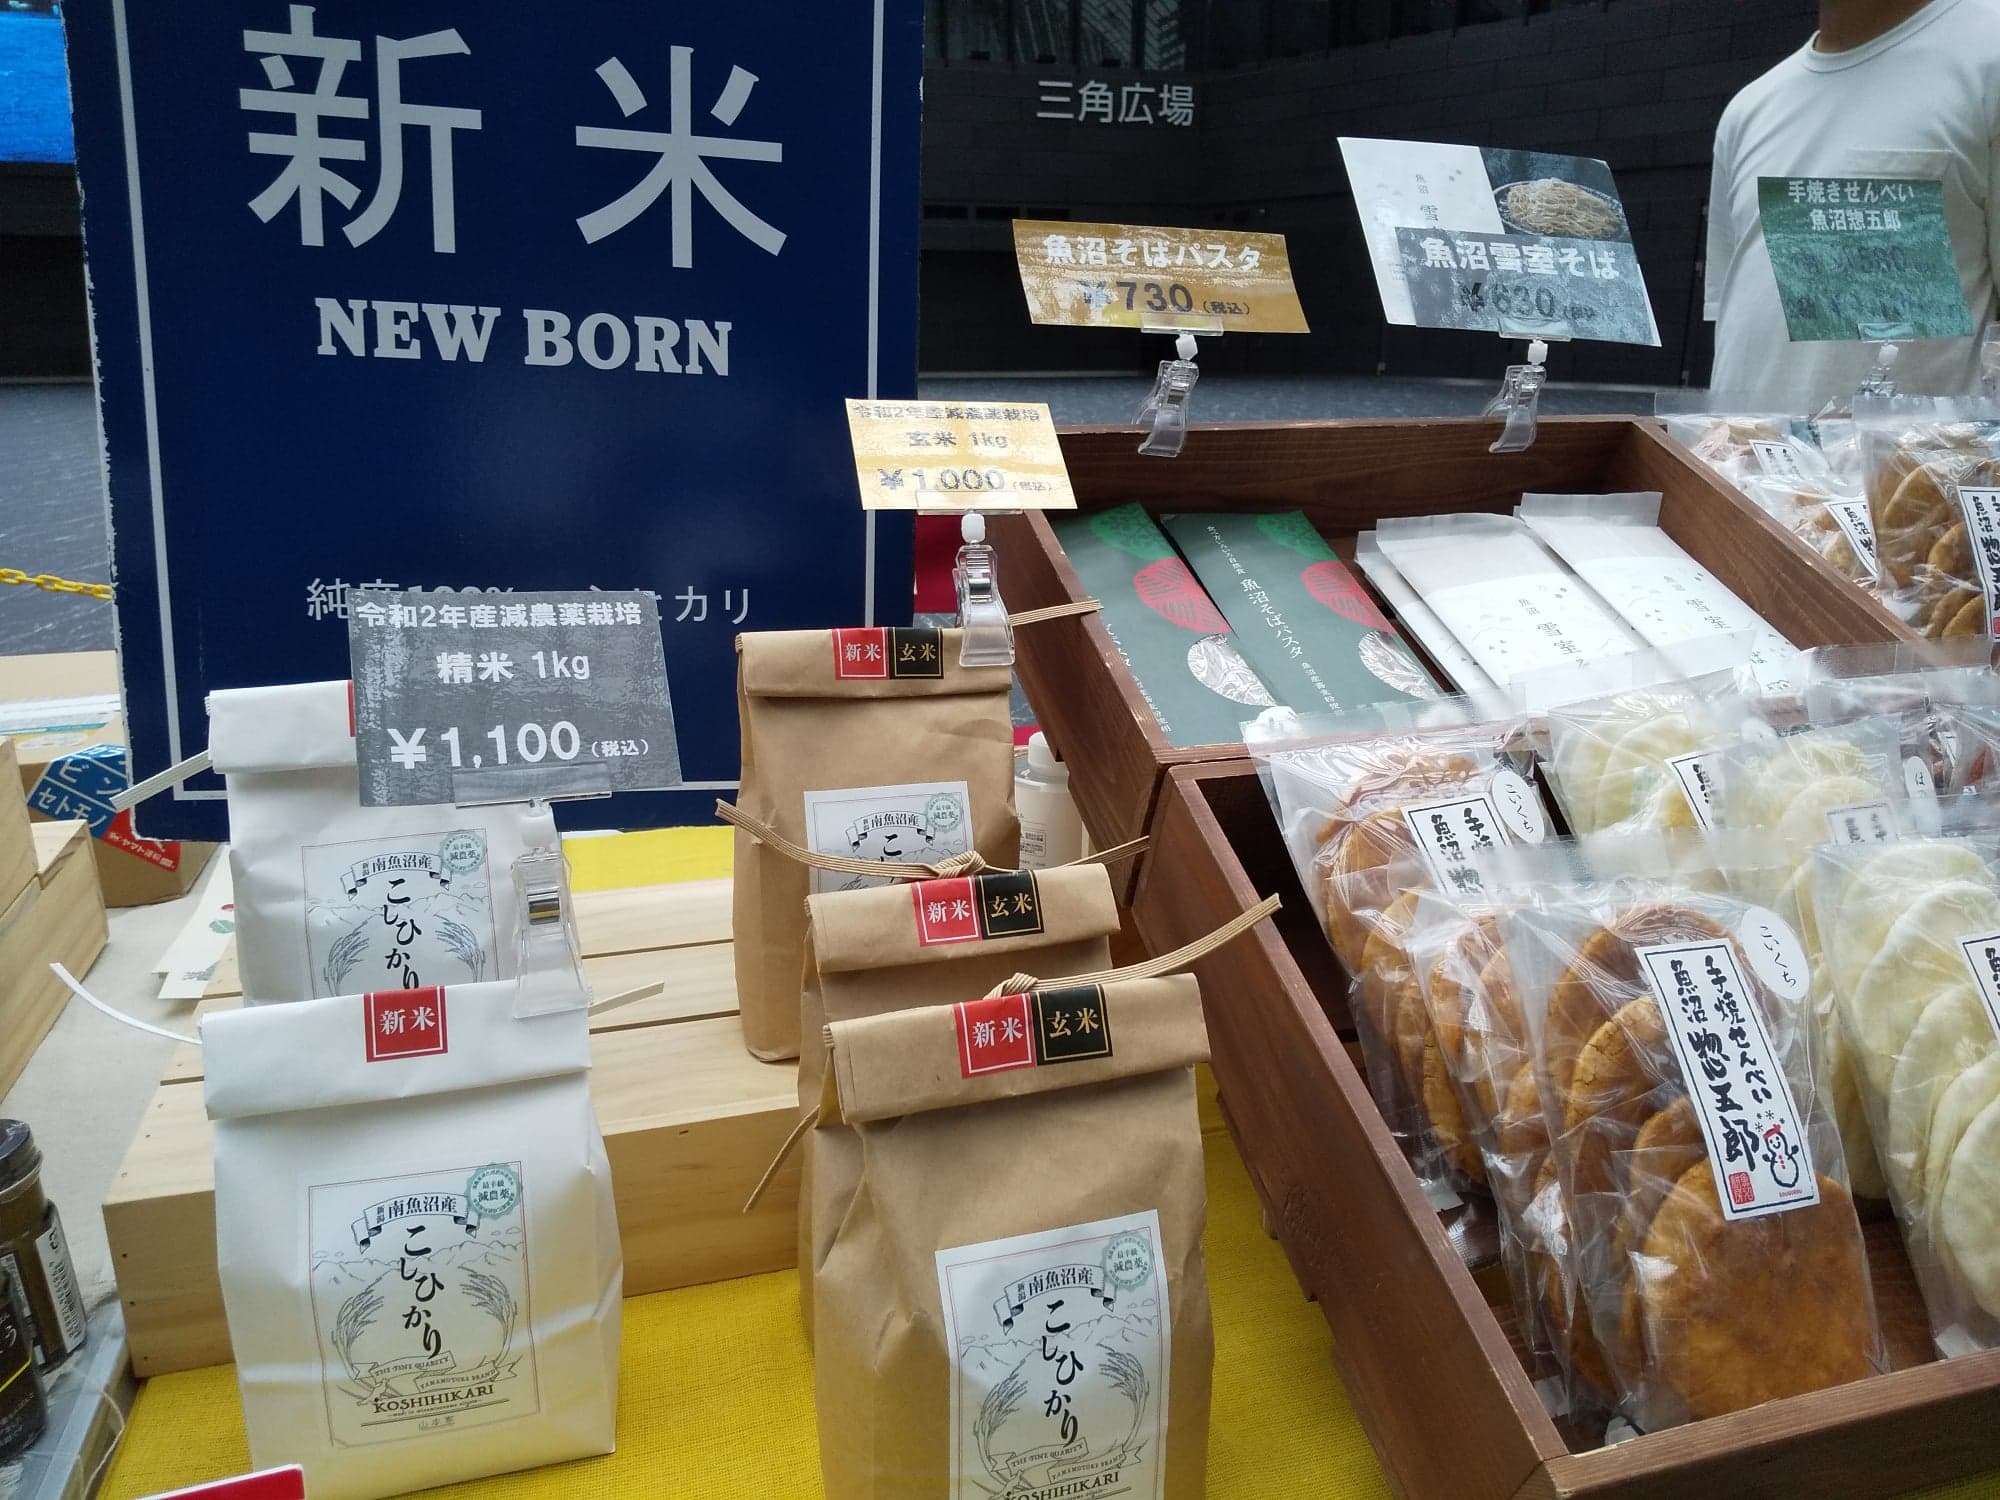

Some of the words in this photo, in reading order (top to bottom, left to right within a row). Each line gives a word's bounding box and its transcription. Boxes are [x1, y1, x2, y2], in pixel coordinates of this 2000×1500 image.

[1036, 80, 1195, 127] 三角広場
[1788, 180, 1915, 204] 手焼きせんべい
[1043, 234, 1263, 272] 魚沼そばパスタ
[1420, 237, 1620, 280] 魚沼雪室そば
[315, 297, 501, 363] NEW
[523, 308, 733, 377] BORN
[905, 431, 957, 448] 玄米
[969, 431, 1009, 449] 1kg
[355, 601, 642, 629] 令和2年産減農薬栽培
[435, 651, 514, 684] 精米
[531, 650, 591, 681] 1kg
[845, 642, 882, 662] 新米
[899, 643, 937, 662] 玄米
[387, 720, 581, 769] ¥1,100
[371, 850, 433, 873] 南魚沼産
[927, 897, 971, 924] 新米
[990, 892, 1033, 919] 玄米
[382, 878, 423, 990] こしひかり
[380, 1005, 436, 1036] 新米
[972, 1016, 1024, 1049] 新米
[1047, 1006, 1100, 1038] 玄米
[388, 1195, 458, 1219] 南魚沼産
[399, 1224, 445, 1360] こしひかり
[1028, 1266, 1095, 1297] 南魚沼産
[1041, 1299, 1084, 1448] こしひかり
[374, 1384, 495, 1414] KOSHIHIKARI
